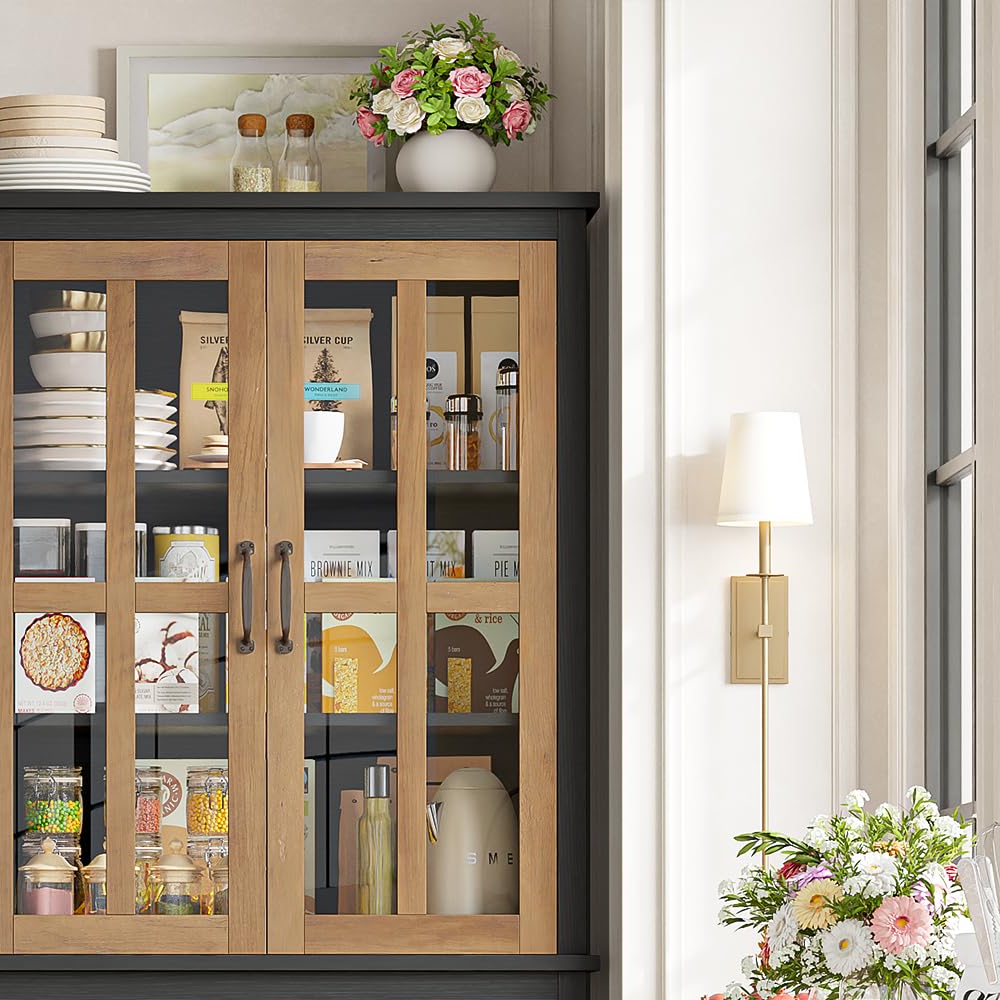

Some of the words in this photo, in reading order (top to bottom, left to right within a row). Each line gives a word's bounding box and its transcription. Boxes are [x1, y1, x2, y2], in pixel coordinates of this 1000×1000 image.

[335, 336, 353, 344] CUP
[311, 561, 352, 577] BROWNIE
[357, 561, 373, 577] MIX
[440, 561, 456, 577] MIX
[494, 561, 509, 577] PIE
[485, 615, 503, 624] rice
